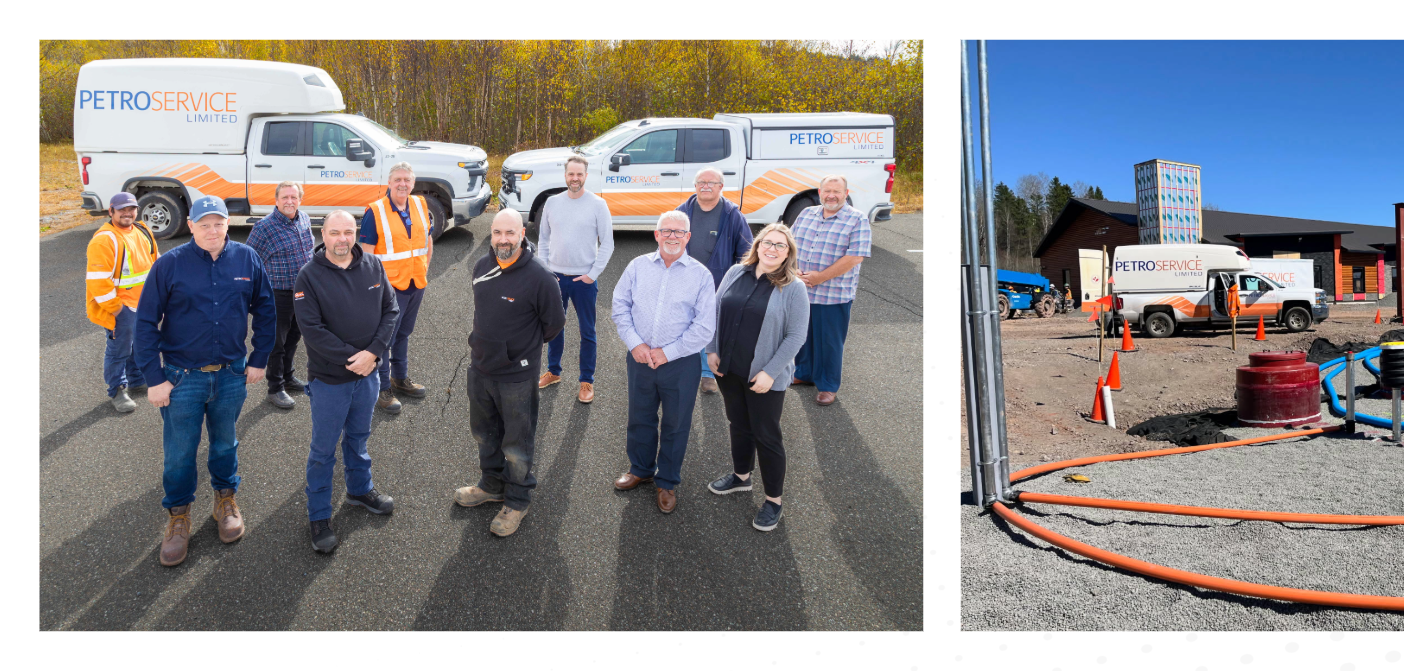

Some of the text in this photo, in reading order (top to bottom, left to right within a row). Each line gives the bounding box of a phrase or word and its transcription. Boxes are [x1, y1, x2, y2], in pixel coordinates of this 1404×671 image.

[79, 90, 237, 112] PETROSERVICE
[187, 114, 238, 123] LIMITED
[790, 132, 884, 144] PETROSERVICE
[320, 170, 372, 178] PETROSERVICE
[606, 176, 660, 184] PETROSERVICE
[1115, 260, 1203, 272] PETROSERVICE
